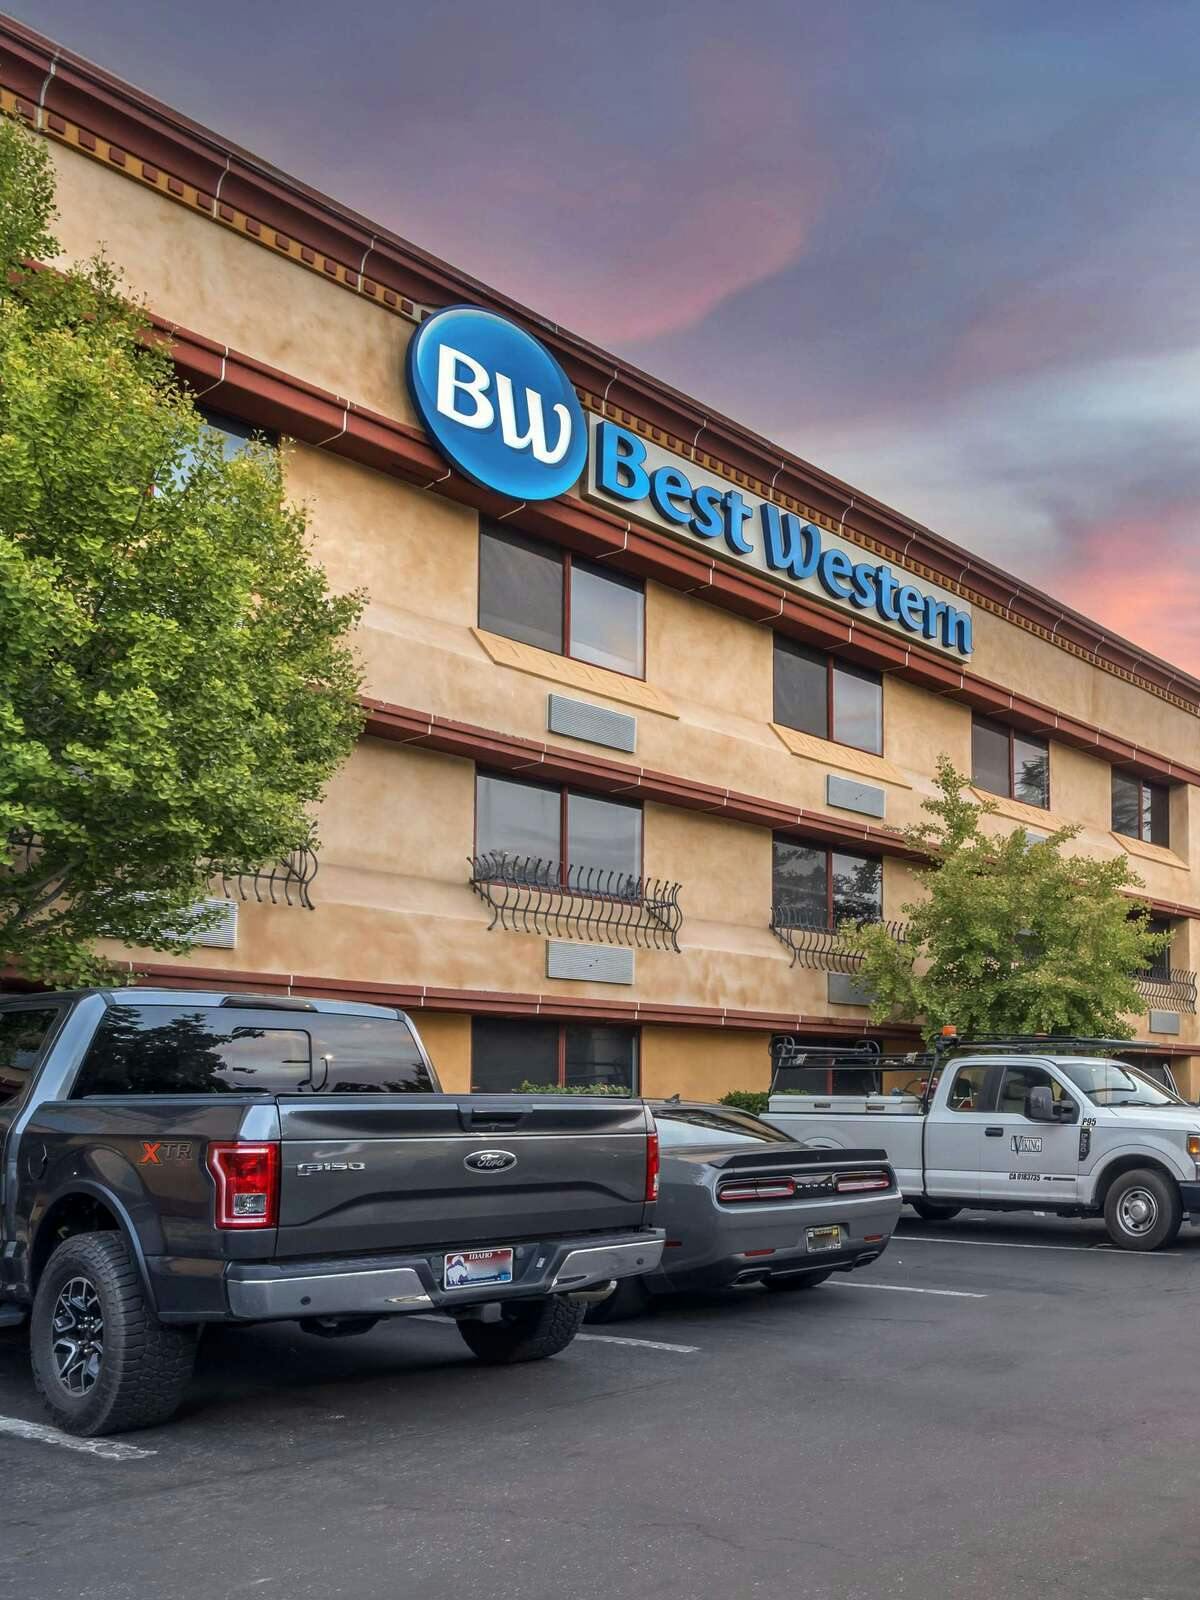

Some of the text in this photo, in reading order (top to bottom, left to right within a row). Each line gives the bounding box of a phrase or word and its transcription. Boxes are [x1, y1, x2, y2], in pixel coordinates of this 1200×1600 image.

[437, 343, 572, 464] BW
[596, 421, 974, 655] Best Western
[137, 1140, 193, 1165] XTR
[477, 1153, 506, 1168] Ford
[469, 1252, 493, 1260] IDAHO
